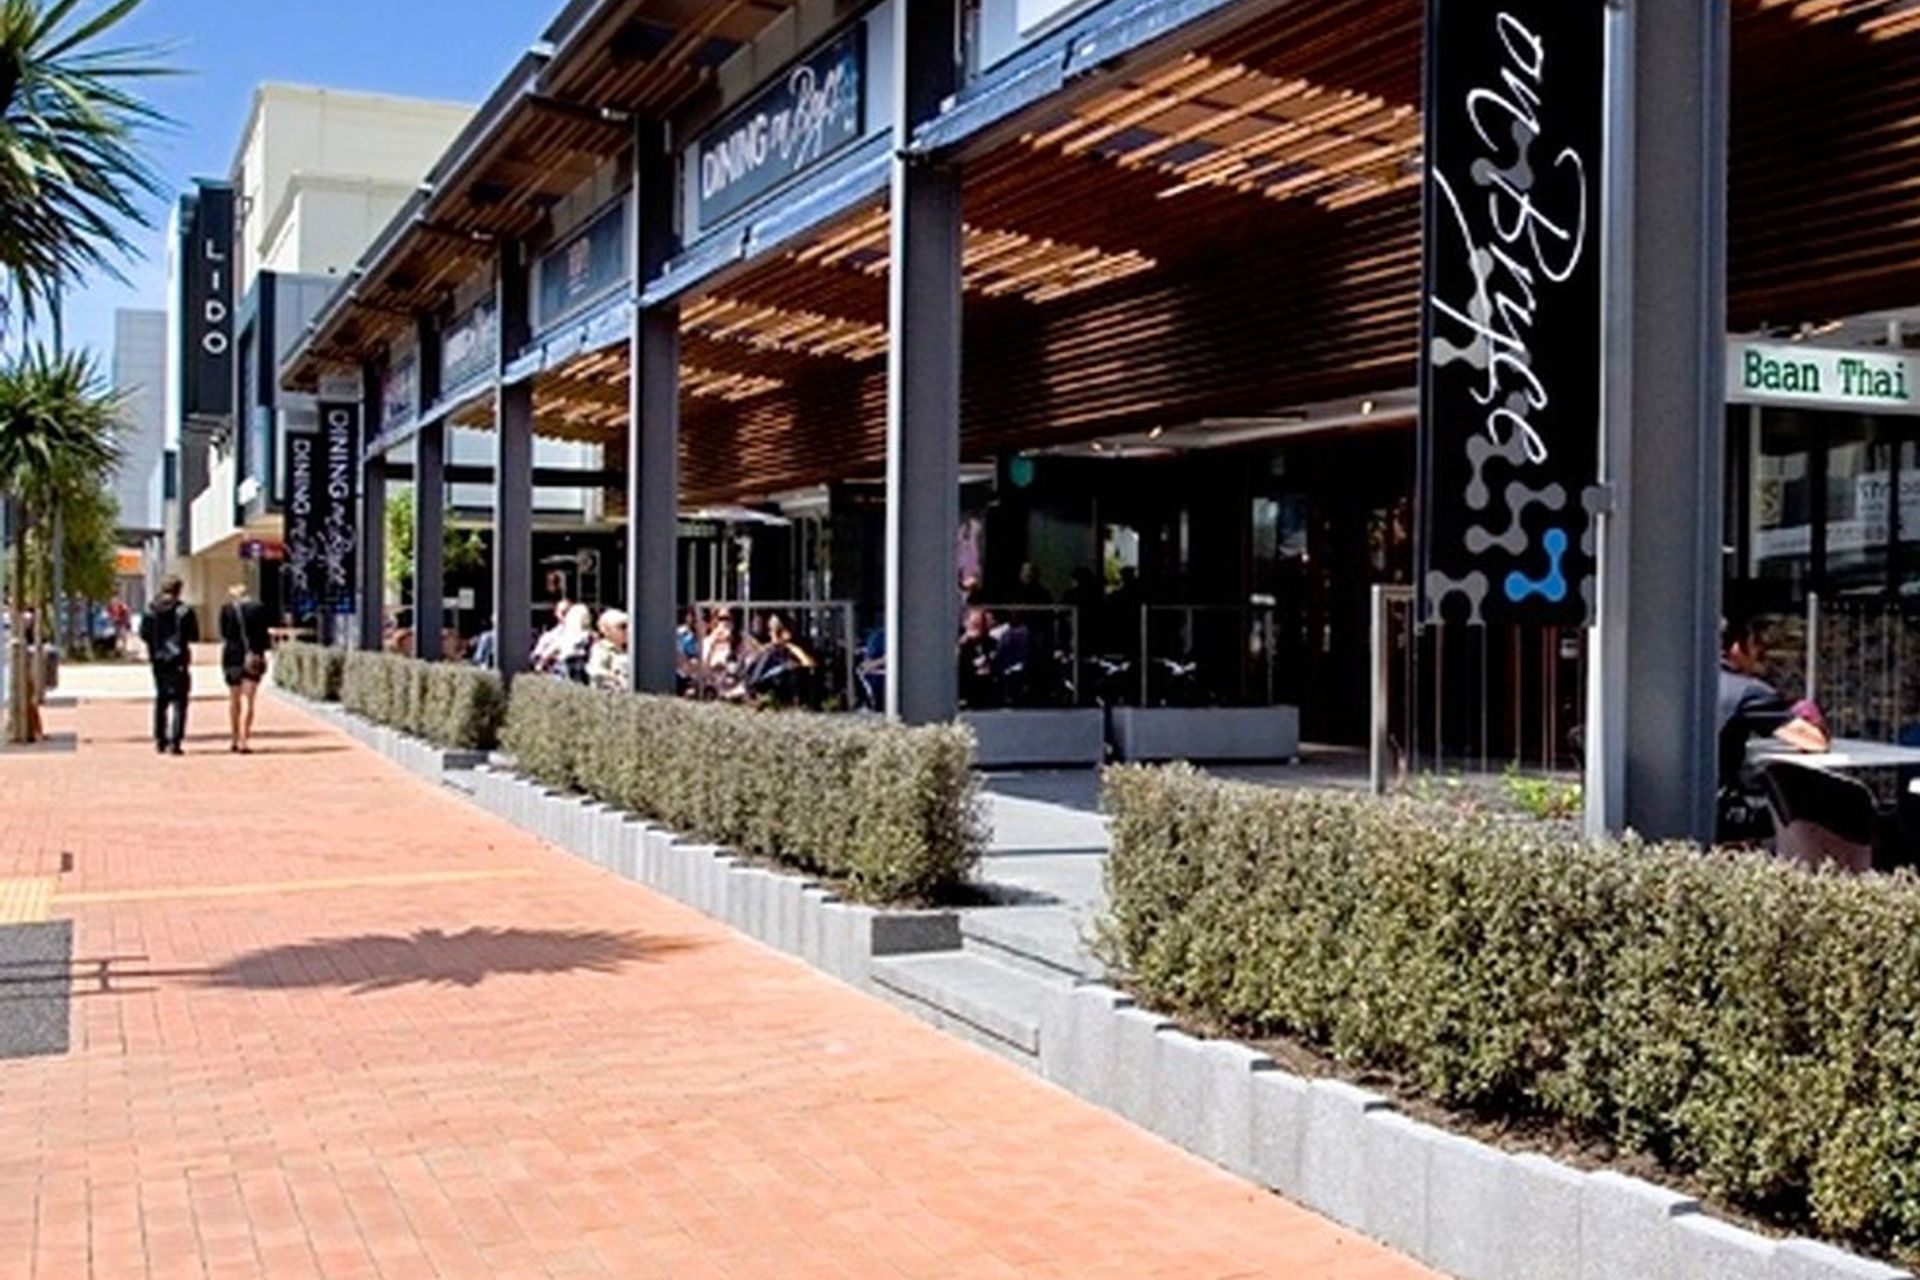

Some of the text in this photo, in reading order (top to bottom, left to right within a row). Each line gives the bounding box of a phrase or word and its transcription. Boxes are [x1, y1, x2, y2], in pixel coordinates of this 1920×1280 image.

[703, 113, 768, 199] DINING
[1431, 12, 1586, 464] on Bryce
[203, 239, 228, 354] LIDO
[1744, 349, 1908, 399] Baan Thai
[328, 409, 349, 499] DINING
